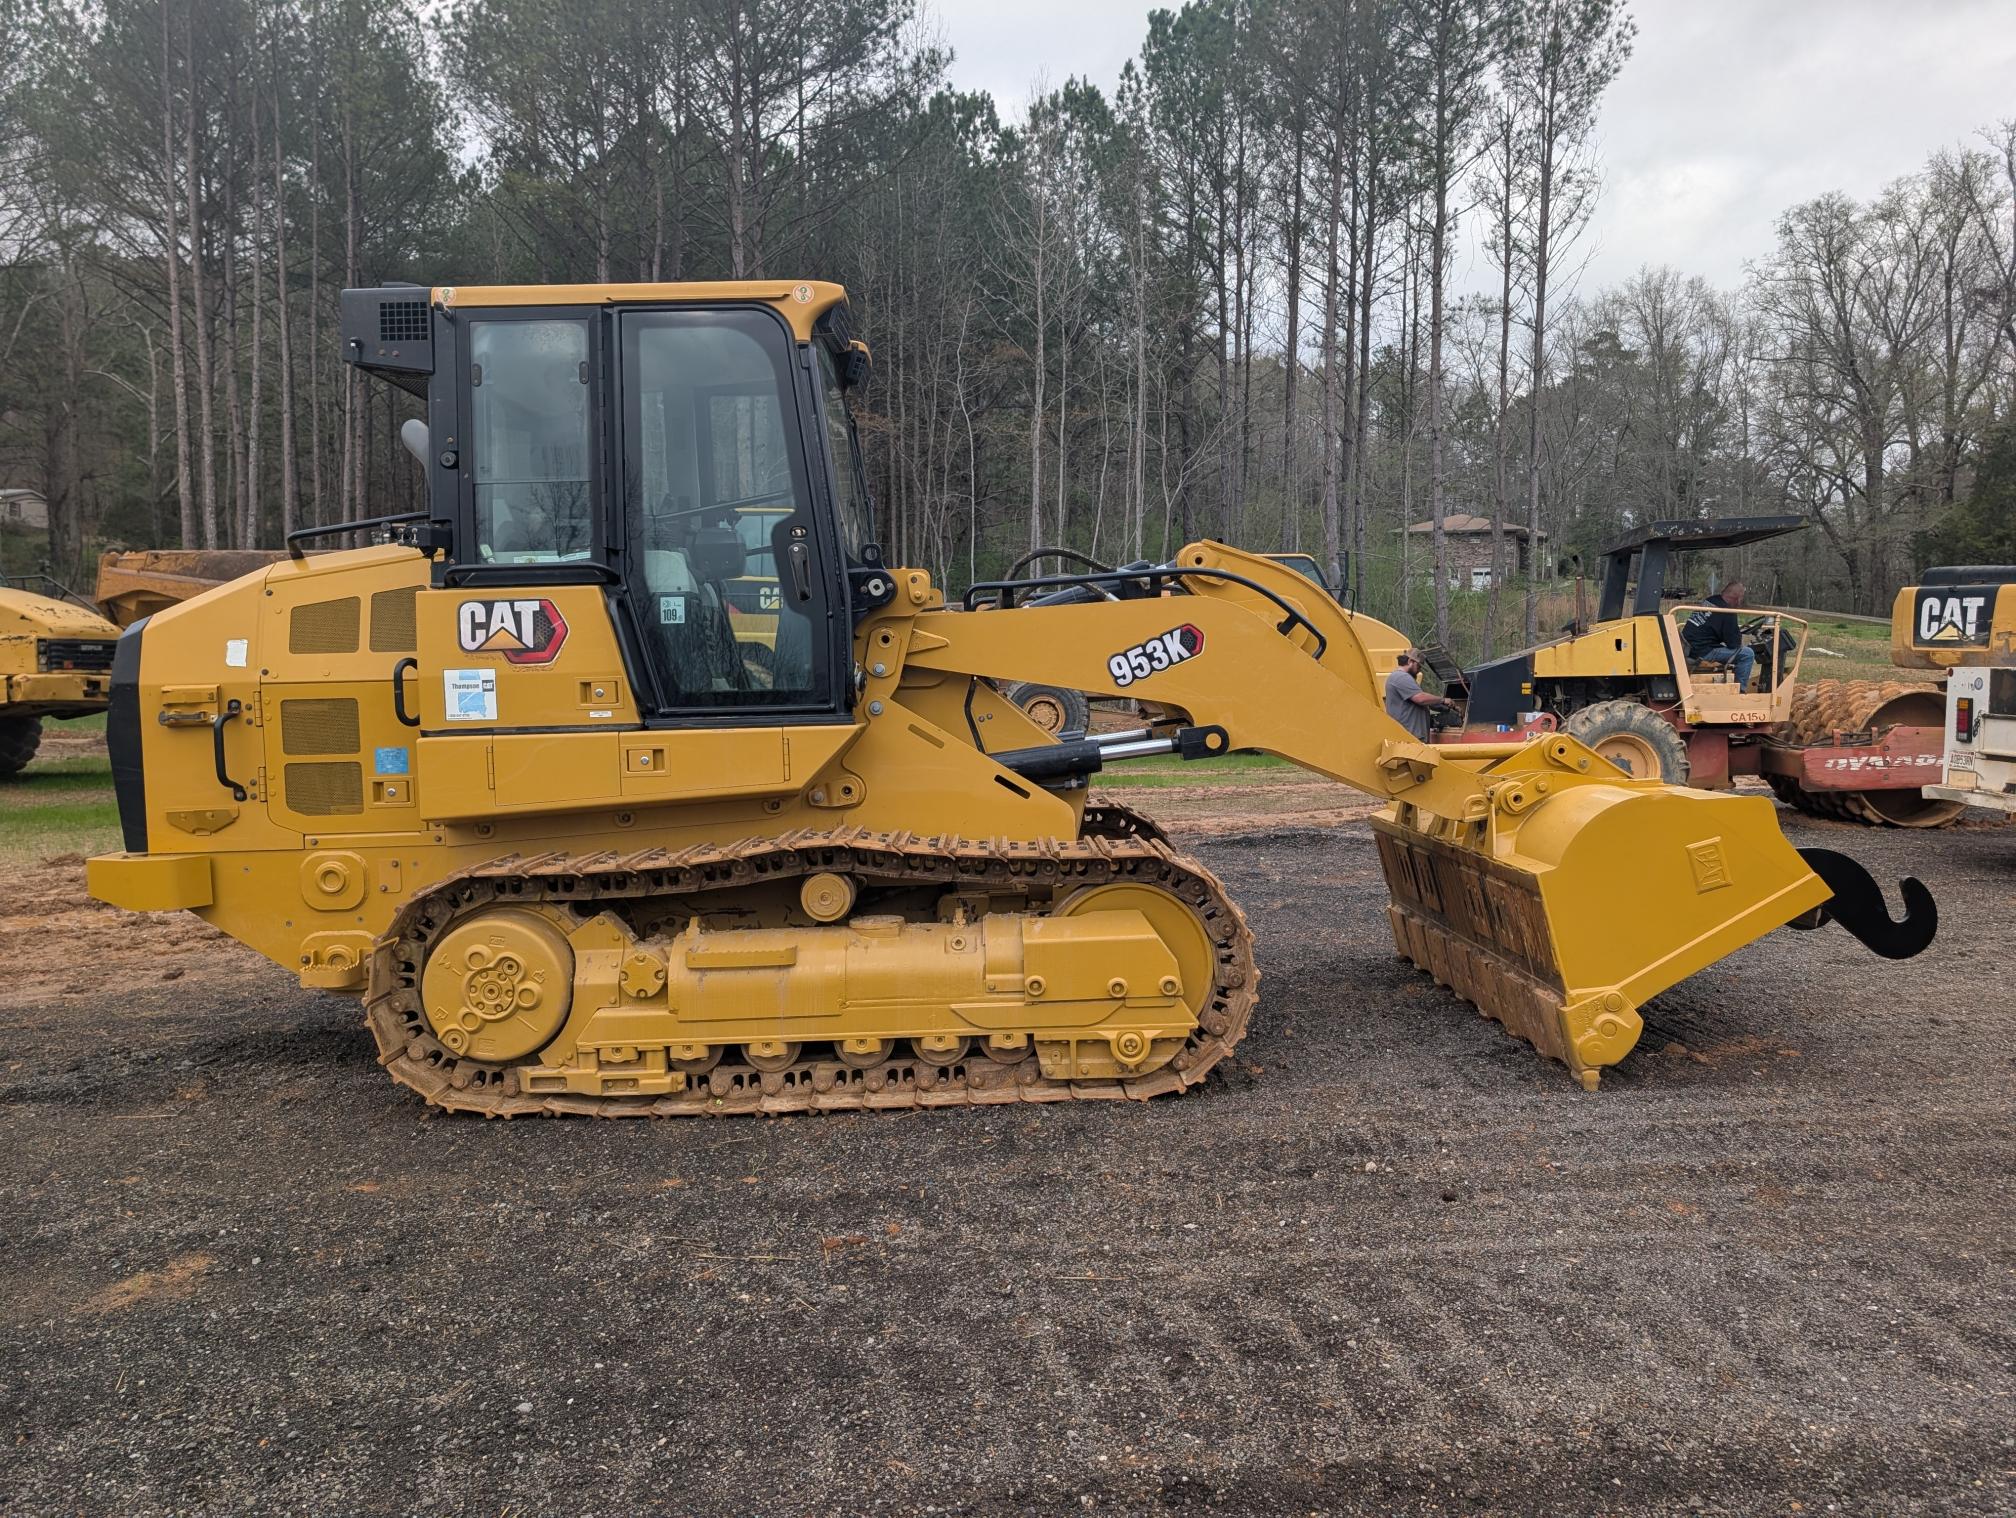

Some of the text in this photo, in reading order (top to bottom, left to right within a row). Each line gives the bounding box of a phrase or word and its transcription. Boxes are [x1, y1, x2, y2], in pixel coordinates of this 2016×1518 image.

[460, 600, 540, 651] CAT
[662, 609, 677, 621] 109
[1920, 597, 1984, 640] CAT
[1109, 628, 1191, 686] 953K
[1694, 845, 1726, 886] CAT
